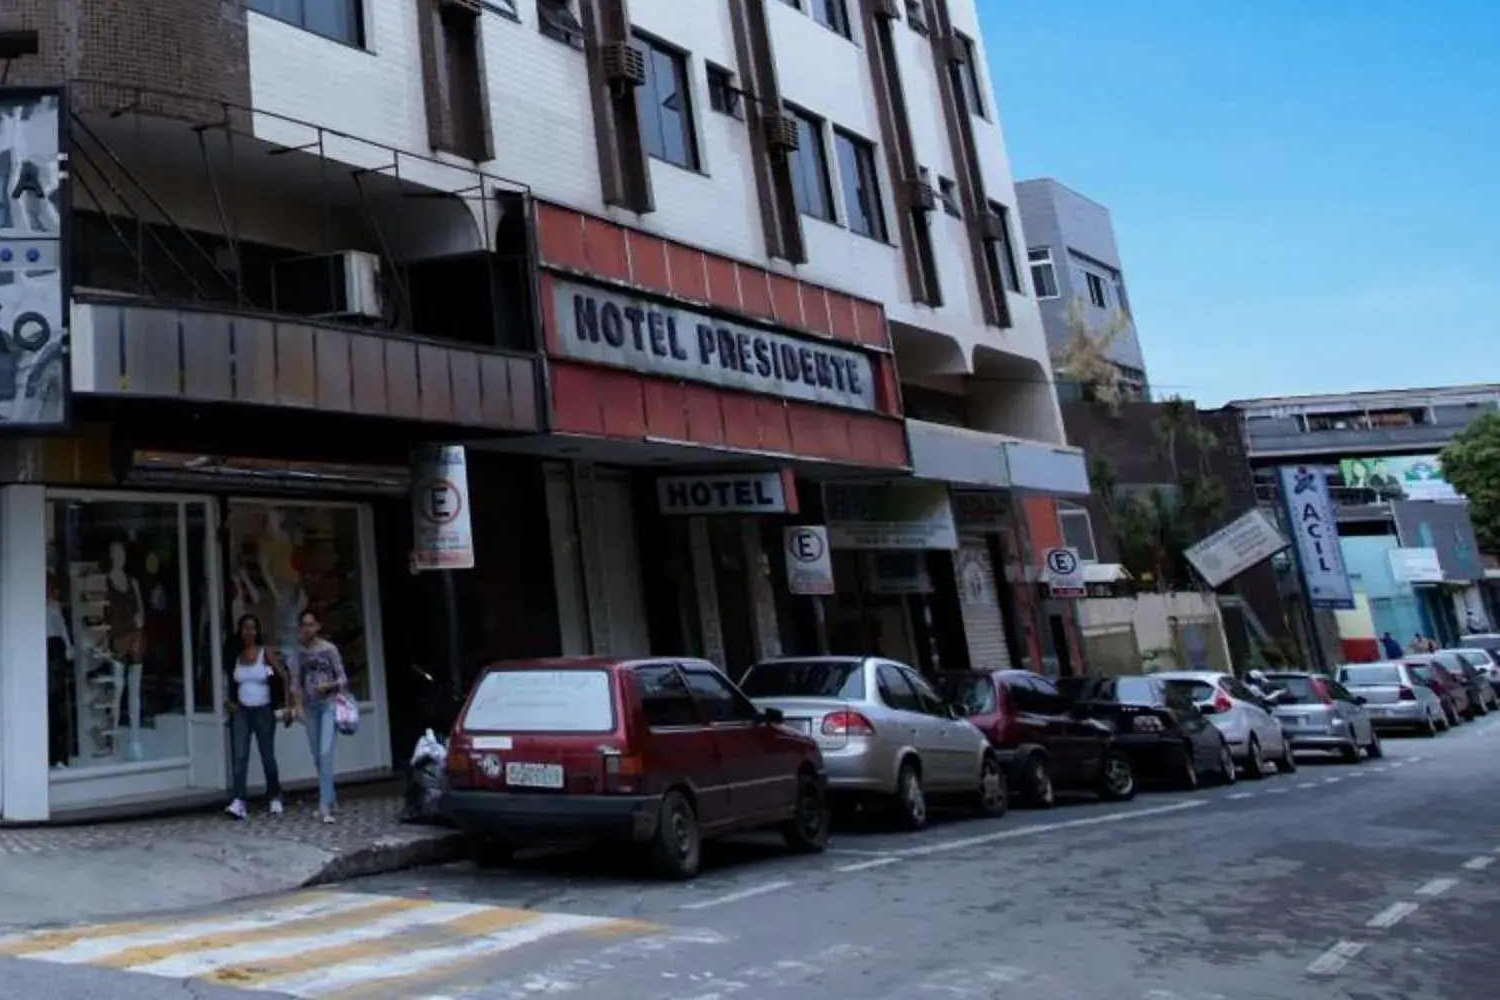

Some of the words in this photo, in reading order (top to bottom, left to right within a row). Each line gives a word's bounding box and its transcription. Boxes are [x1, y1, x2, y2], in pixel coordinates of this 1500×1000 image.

[572, 293, 688, 361] HOTEL
[696, 322, 863, 395] PRESIDENTE
[431, 486, 451, 517] E
[666, 480, 774, 508] HOTEL
[797, 533, 814, 558] E
[1303, 503, 1331, 572] ACIL
[1055, 554, 1069, 571] E
